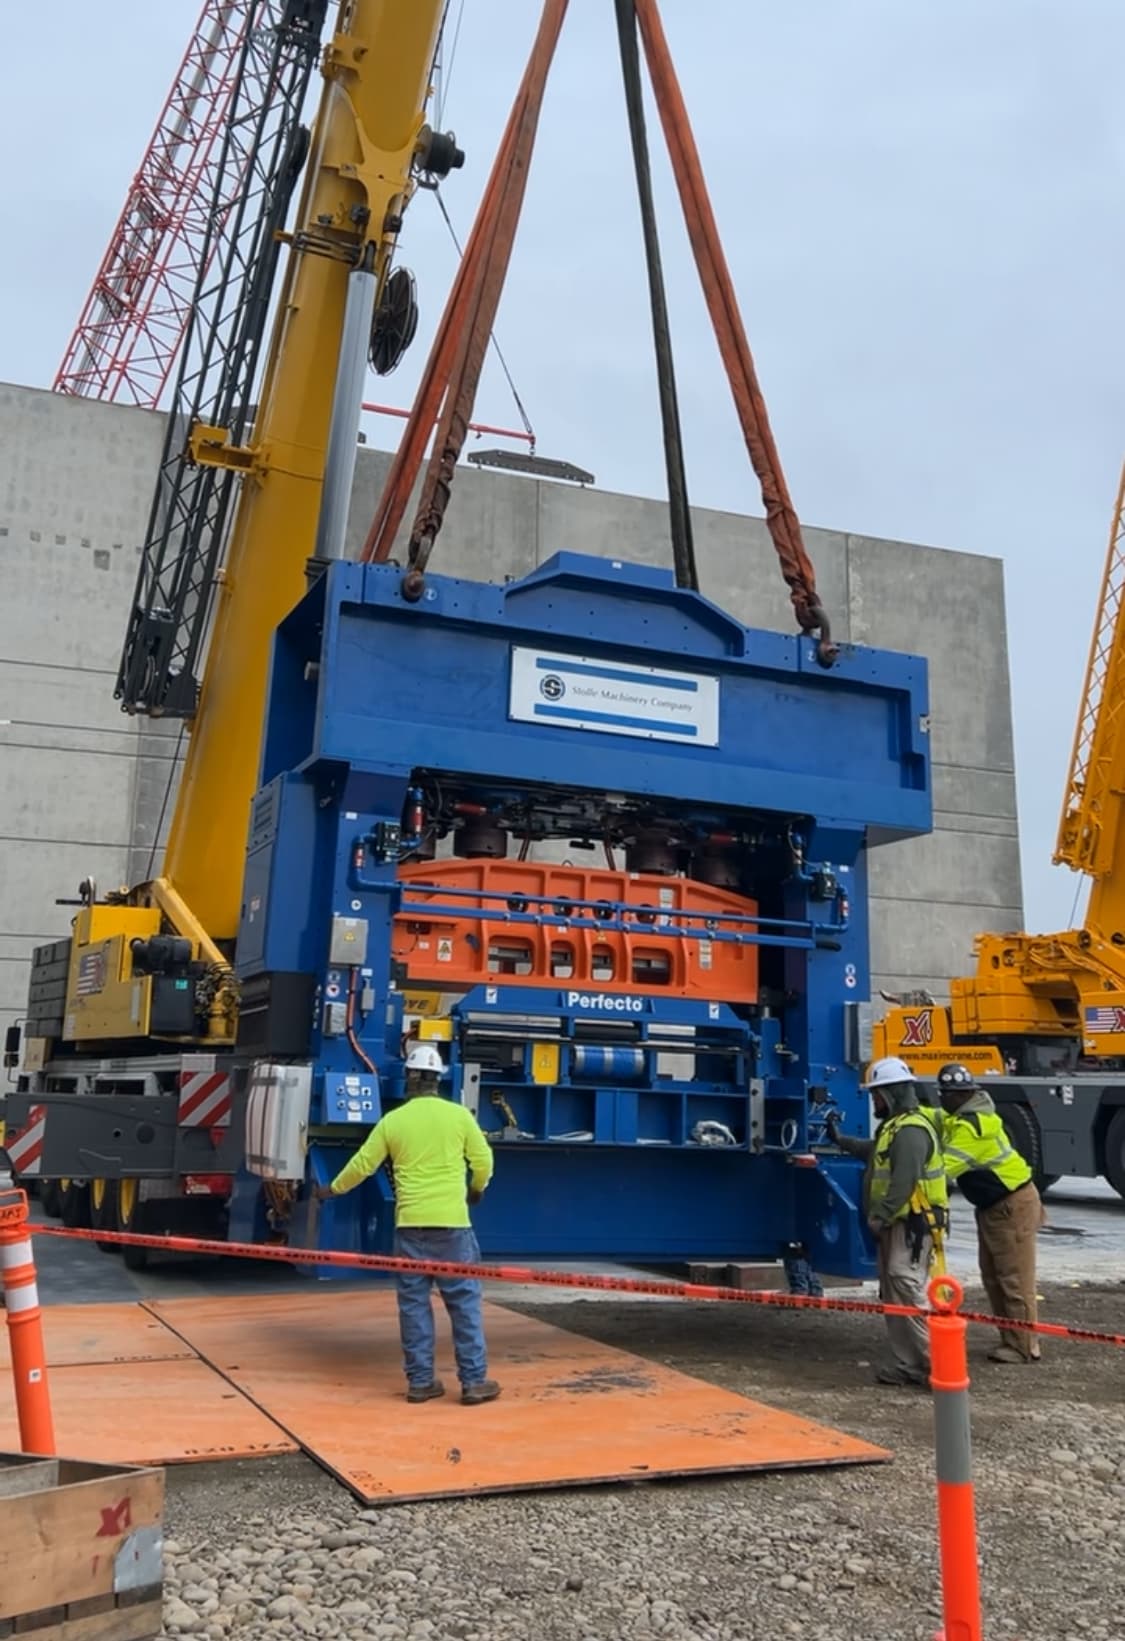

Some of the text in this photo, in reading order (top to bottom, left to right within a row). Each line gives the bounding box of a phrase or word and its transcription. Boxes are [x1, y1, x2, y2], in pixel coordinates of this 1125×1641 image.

[572, 686, 598, 698] Stolle
[601, 689, 648, 706] Machinery
[650, 697, 694, 712] Company
[568, 991, 643, 1012] Perfecto
